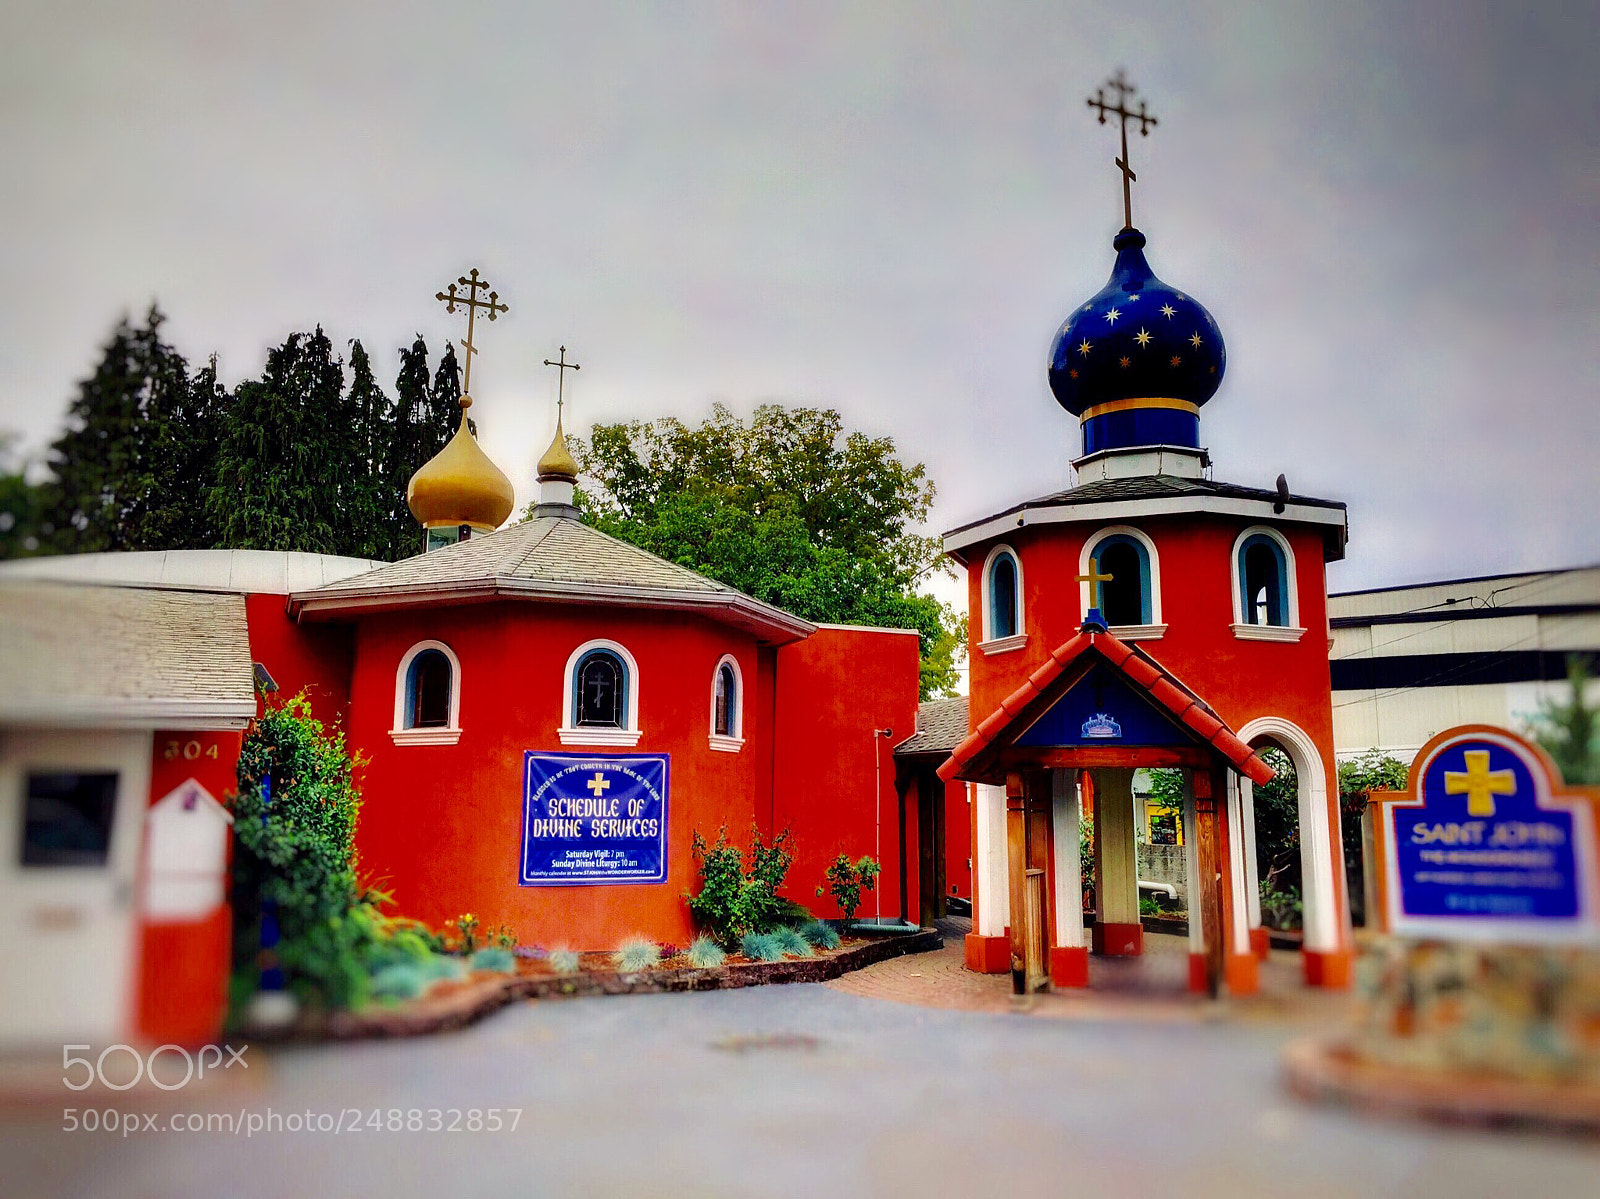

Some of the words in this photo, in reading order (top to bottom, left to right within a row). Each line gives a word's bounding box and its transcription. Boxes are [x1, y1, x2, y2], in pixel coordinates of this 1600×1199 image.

[164, 740, 219, 760] 304
[548, 798, 620, 818] SCHEDULE
[628, 798, 645, 817] OF
[533, 818, 583, 838] DIVINE
[591, 818, 658, 838] SERVICES
[1410, 821, 1486, 846] SAINT
[551, 859, 575, 870] Sunday
[576, 859, 595, 868] Divine
[596, 859, 620, 869] Liturgy:
[621, 858, 628, 867] 10
[566, 850, 593, 859] Saturday
[594, 849, 610, 860] Vigil:
[615, 851, 625, 860] pm
